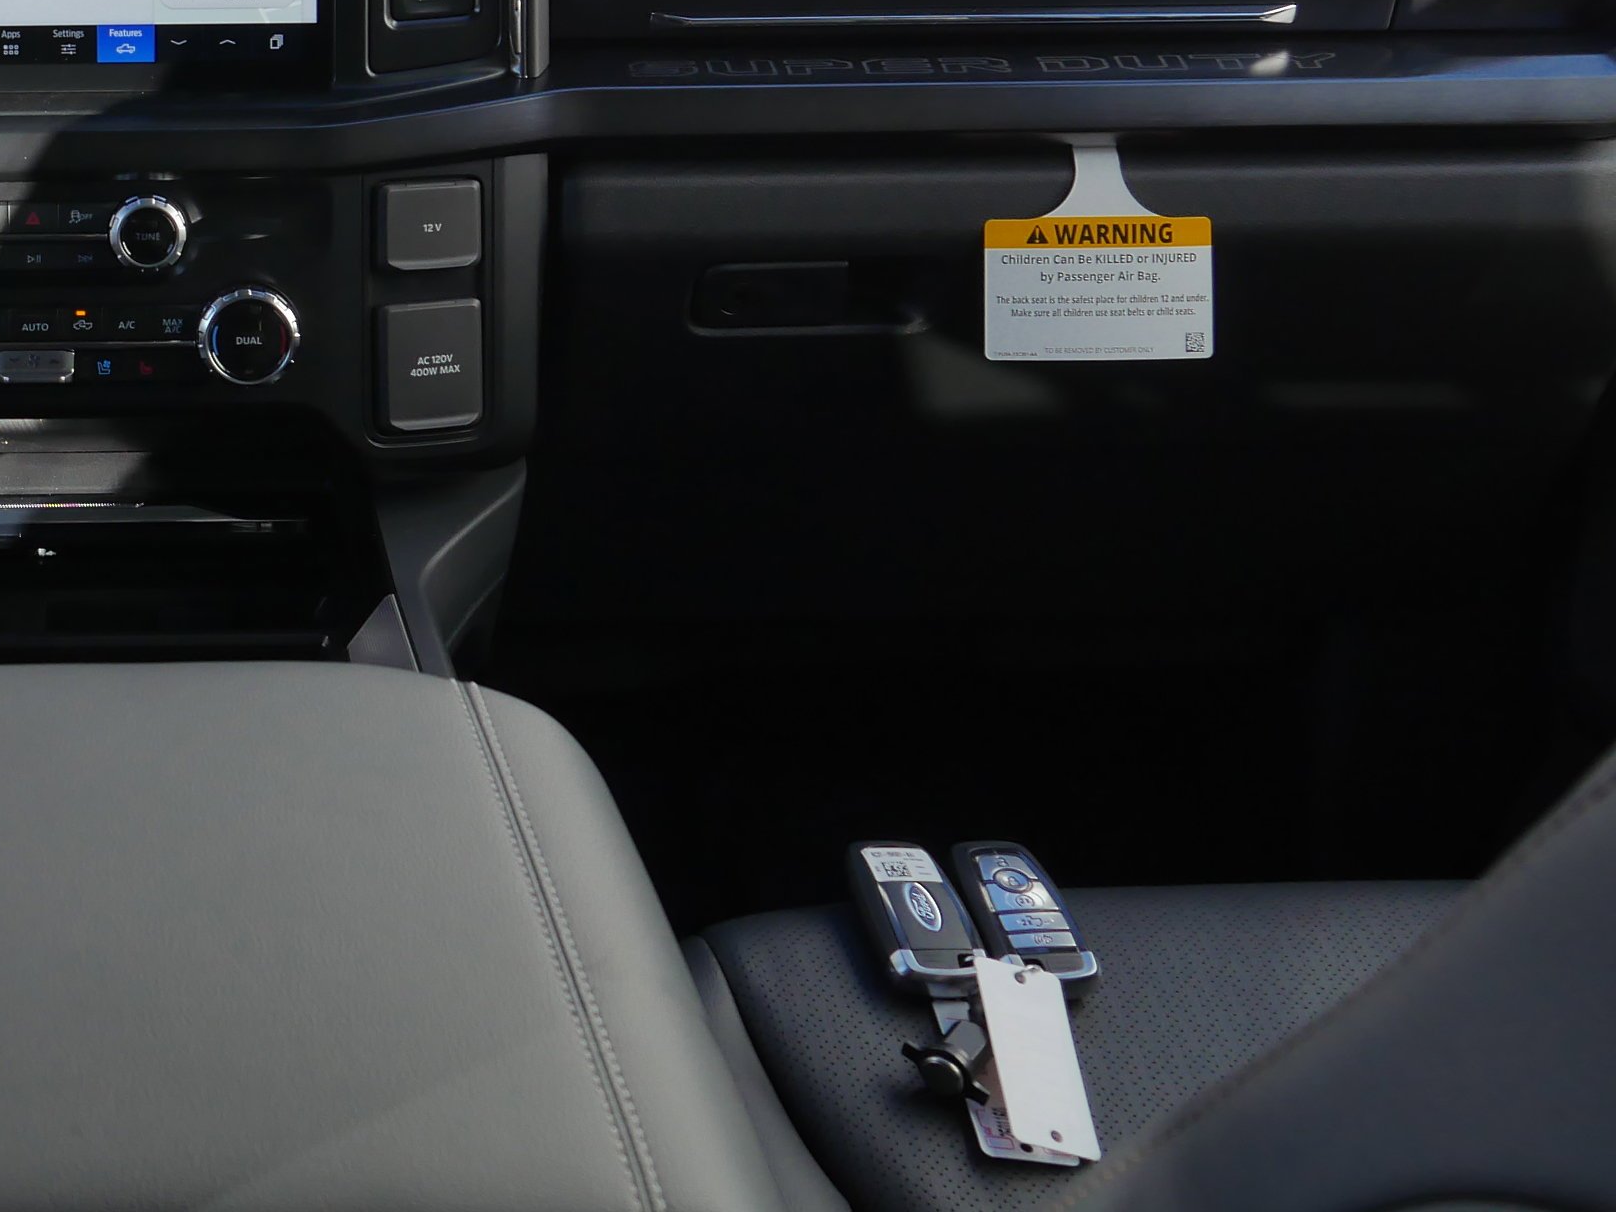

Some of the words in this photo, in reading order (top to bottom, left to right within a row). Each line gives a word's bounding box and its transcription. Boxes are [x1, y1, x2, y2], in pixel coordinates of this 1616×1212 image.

[1, 30, 21, 41] Apps
[53, 29, 84, 40] Settings
[109, 28, 143, 38] Features
[628, 55, 1013, 78] SUPER
[1039, 52, 1336, 74] DUTY
[422, 224, 434, 233] 12
[435, 223, 442, 232] V
[135, 232, 161, 241] TUNE
[1054, 222, 1173, 245] WARNING
[1001, 254, 1050, 265] Children
[1053, 254, 1074, 264] Can
[1078, 254, 1092, 264] Be
[1096, 254, 1134, 264] KILLED
[1152, 252, 1197, 264] INJURED
[1040, 272, 1053, 284] by
[1057, 272, 1115, 284] Passenger
[1118, 271, 1135, 281] Air
[1137, 271, 1161, 284] Bag.
[996, 295, 1010, 304] The
[1012, 295, 1030, 304] back
[1031, 296, 1047, 304] seat
[1049, 295, 1056, 304] is
[1057, 295, 1070, 304] the
[1071, 295, 1094, 304] safest
[1095, 295, 1115, 306] place
[1116, 295, 1128, 303] for
[1129, 295, 1159, 303] children
[1160, 294, 1169, 303] 12
[1170, 294, 1184, 302] and
[1186, 294, 1209, 302] under.
[1011, 308, 1032, 317] Make
[1034, 309, 1050, 317] sure
[1052, 308, 1062, 317] all
[1063, 308, 1093, 317] children
[1095, 309, 1108, 317] use
[1109, 309, 1125, 317] seat
[1127, 308, 1145, 316] belts
[1156, 307, 1174, 316] child
[1175, 307, 1196, 315] seats.
[21, 322, 49, 332] AUTO
[117, 320, 136, 330] A/C
[162, 318, 183, 326] MAX
[164, 326, 182, 334] A/C
[235, 336, 262, 345] DUAL
[417, 356, 431, 366] AC
[431, 354, 453, 364] 120V
[410, 366, 439, 377] 400W
[439, 364, 461, 375] MAX
